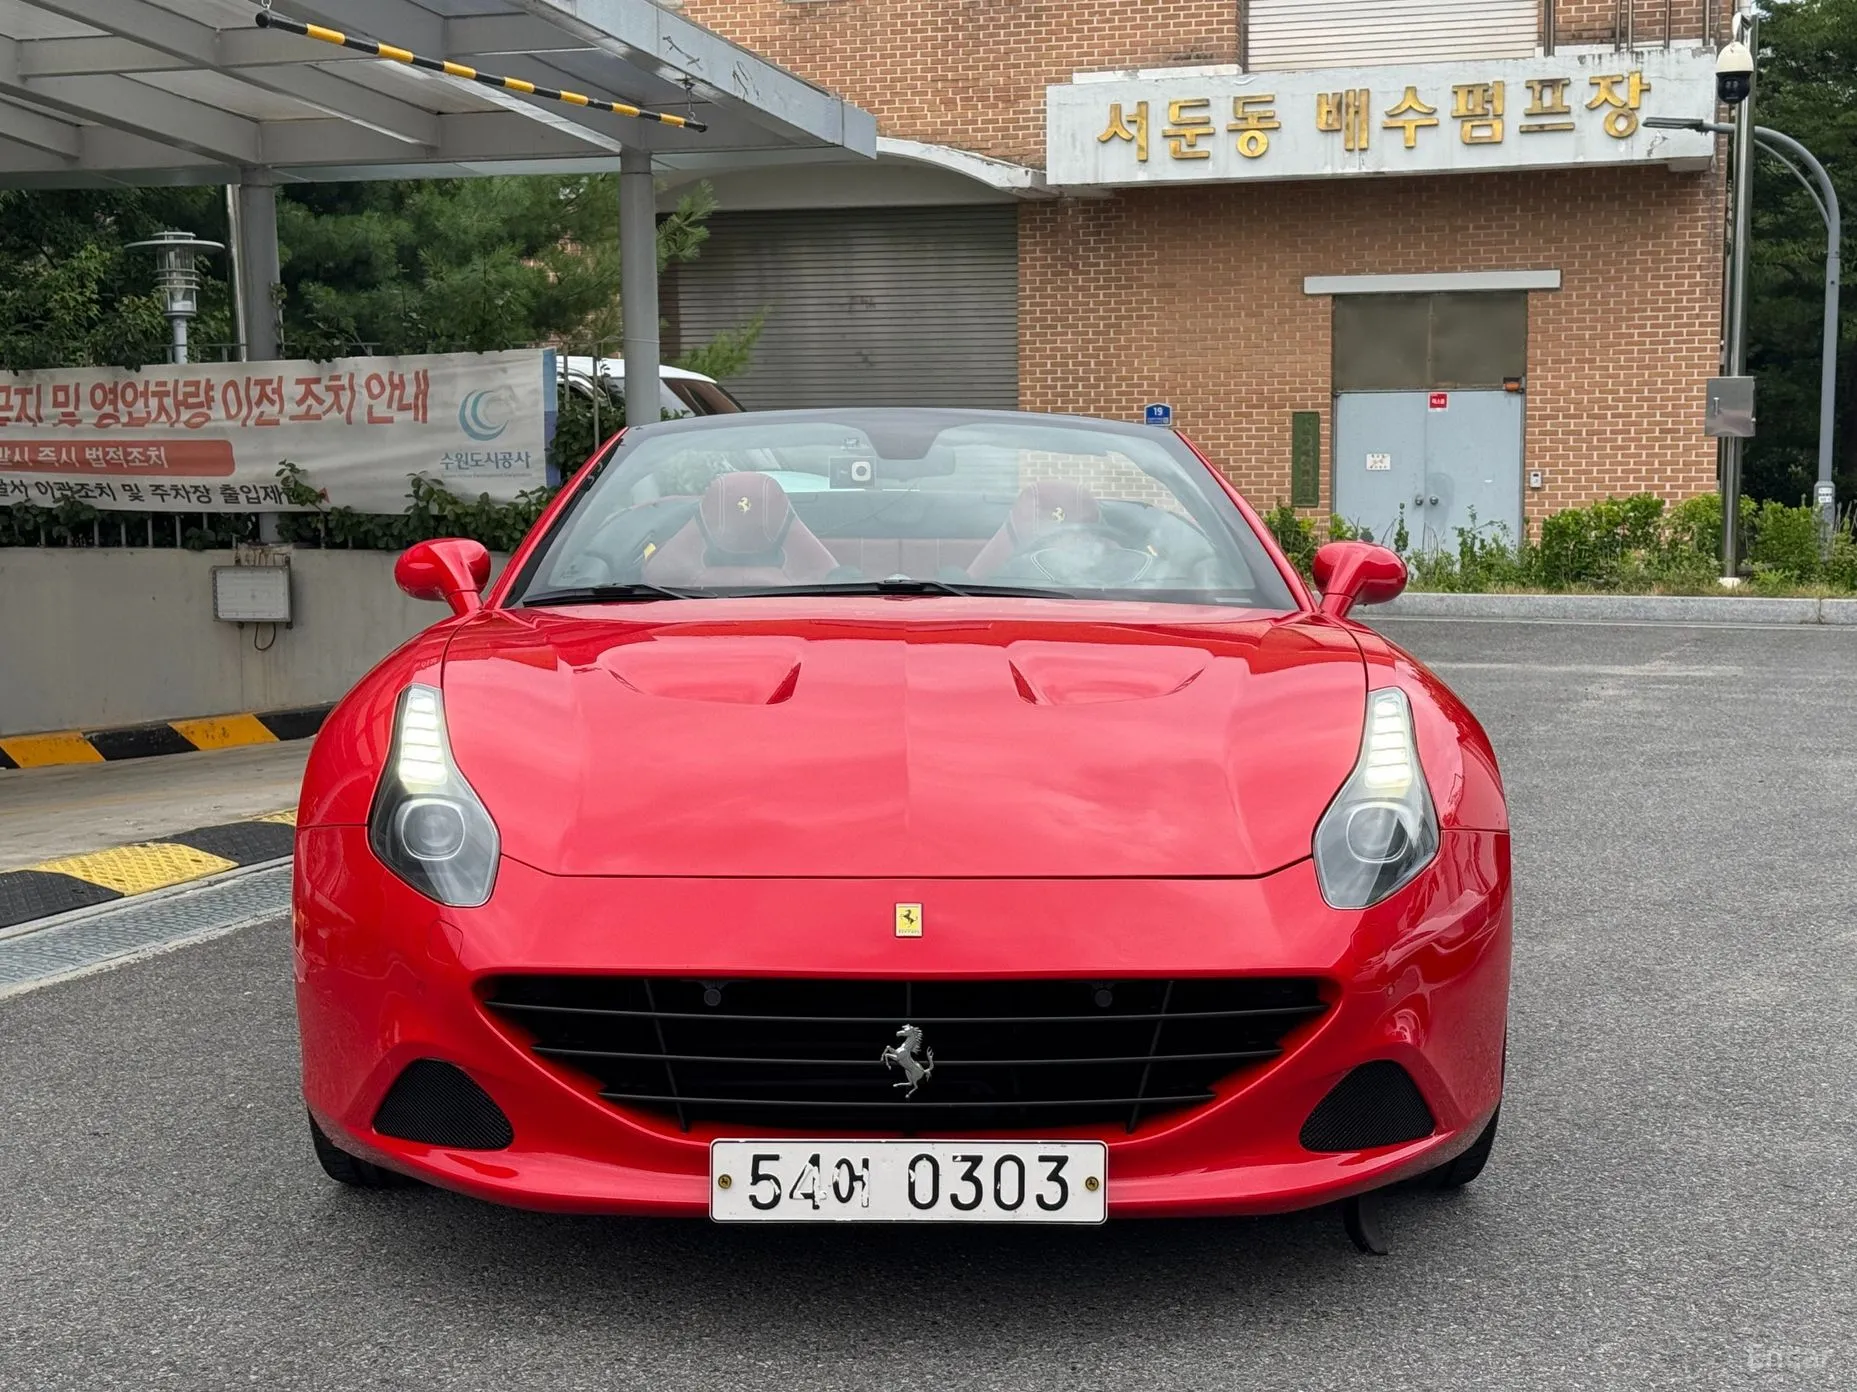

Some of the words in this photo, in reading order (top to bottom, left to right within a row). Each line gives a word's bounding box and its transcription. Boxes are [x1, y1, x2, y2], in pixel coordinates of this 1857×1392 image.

[1097, 93, 1282, 163] 서둔동
[1314, 70, 1653, 153] 배수펌프장
[52, 382, 83, 427] 및
[89, 377, 215, 429] 영업차량
[221, 375, 284, 427] 이전
[288, 372, 357, 426] 조치
[364, 368, 431, 425] 안내
[1153, 406, 1163, 416] 19
[37, 446, 80, 468] 즉시
[85, 446, 169, 469] 법적조치
[440, 450, 532, 471] 수원도시공사
[120, 483, 146, 502] 및
[150, 483, 213, 504] 주차장
[747, 1152, 871, 1211] 54어
[907, 1152, 1070, 1212] 0303
